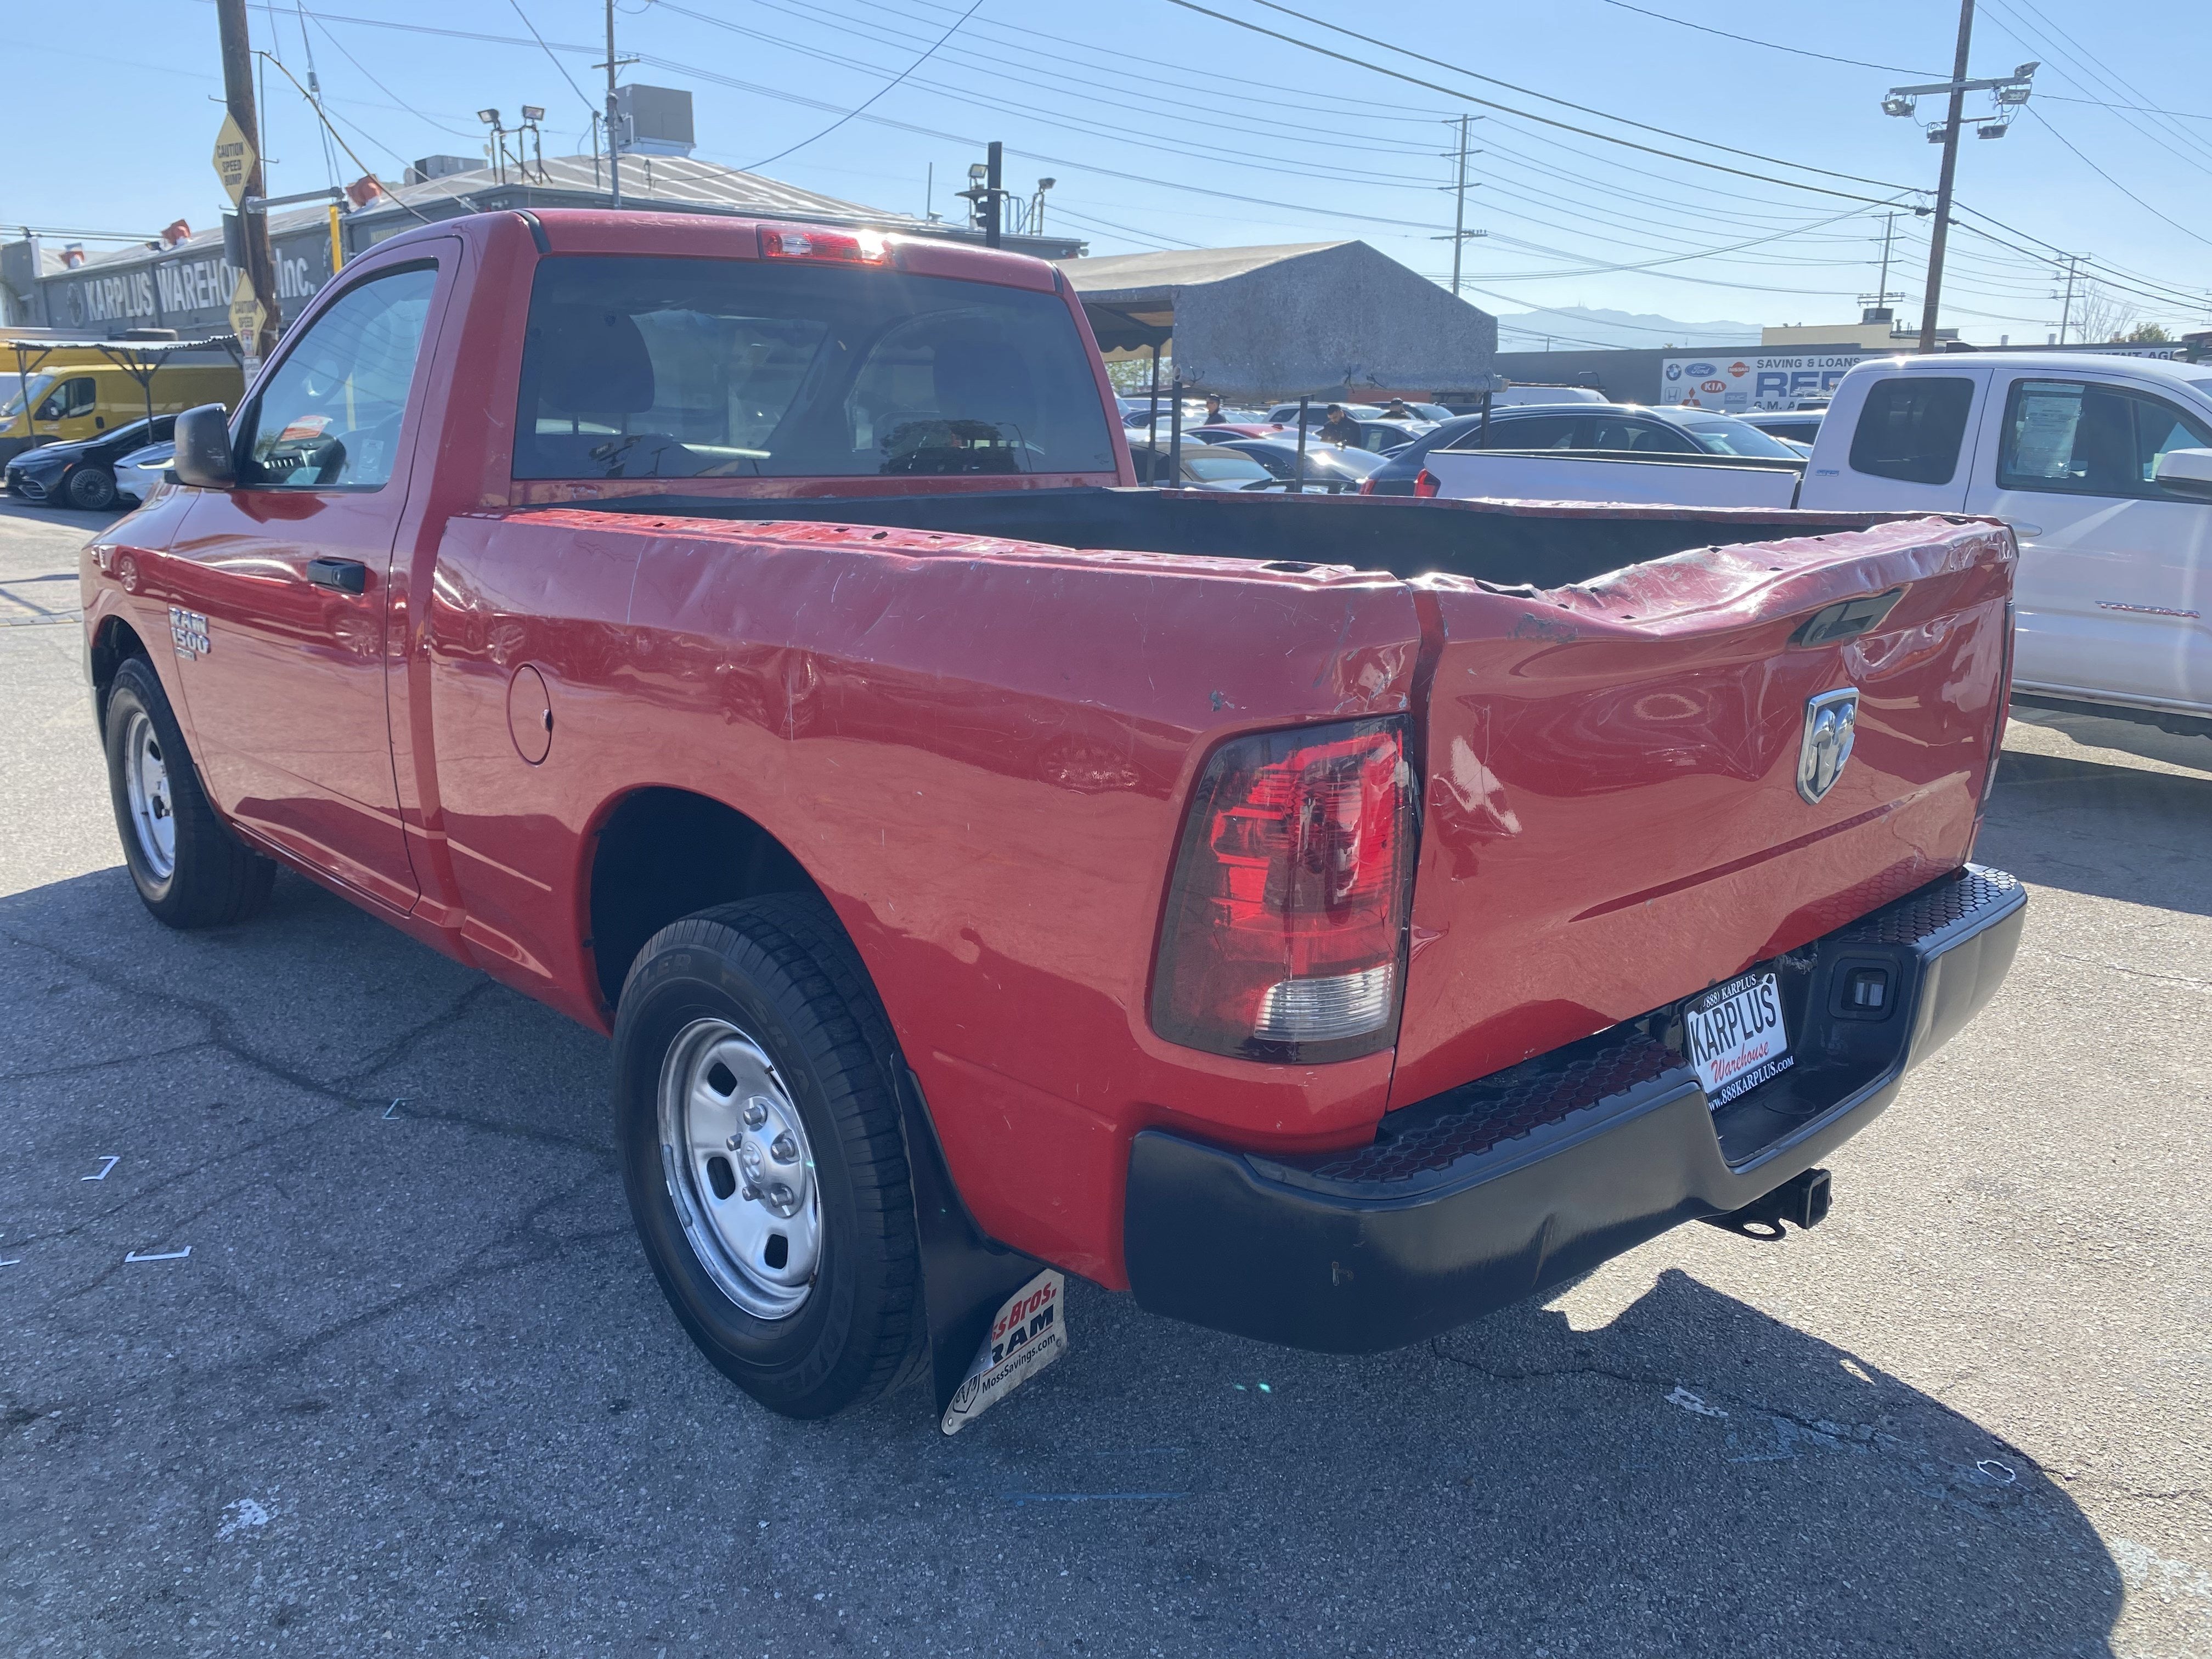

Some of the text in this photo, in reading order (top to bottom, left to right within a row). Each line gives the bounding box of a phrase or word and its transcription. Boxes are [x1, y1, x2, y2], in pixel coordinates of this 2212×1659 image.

[217, 142, 243, 158] CAUTION
[222, 160, 241, 172] SPEED
[224, 173, 241, 186] BUMP
[84, 272, 155, 321] KARPLUS
[275, 248, 317, 298] Inc.
[1691, 366, 1709, 374] Ford
[1757, 358, 1860, 368] SAVING & LOANS
[1704, 383, 1723, 391] KIA
[171, 627, 210, 654] 1500
[1722, 973, 1756, 1001] KARPLUS
[1690, 985, 1776, 1066] KARPLUS
[1711, 1041, 1769, 1084] Warehouse
[1008, 1282, 1057, 1335] Bros.
[991, 1304, 1054, 1364] RAM
[983, 1334, 1055, 1393] MossSavings.com
